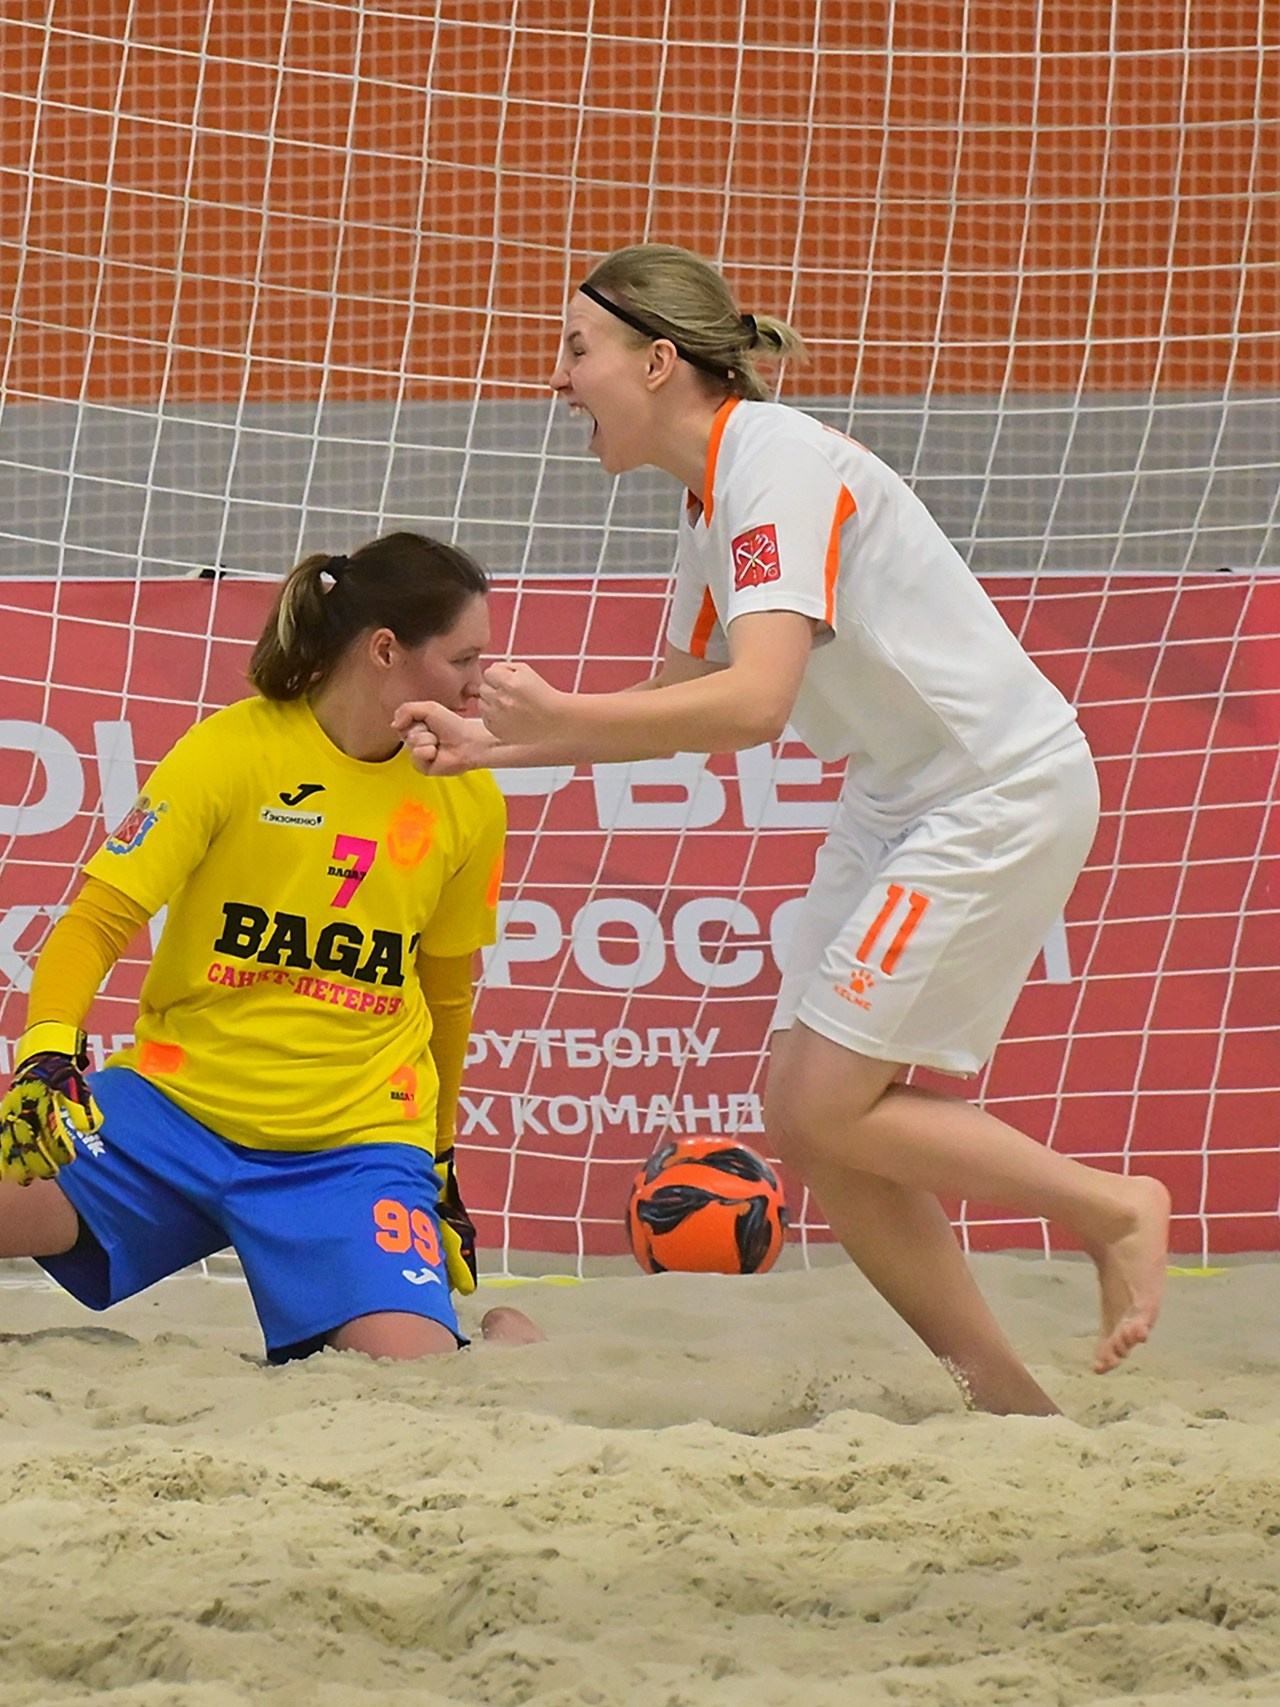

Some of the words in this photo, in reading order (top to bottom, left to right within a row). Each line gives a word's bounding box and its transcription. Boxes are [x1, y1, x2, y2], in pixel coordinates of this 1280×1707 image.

[855, 882, 931, 977] 11
[207, 962, 404, 1016] САНКТ-ПЕТЕРБУ
[510, 1094, 766, 1136] КОМАНД
[373, 1198, 442, 1268] 99
